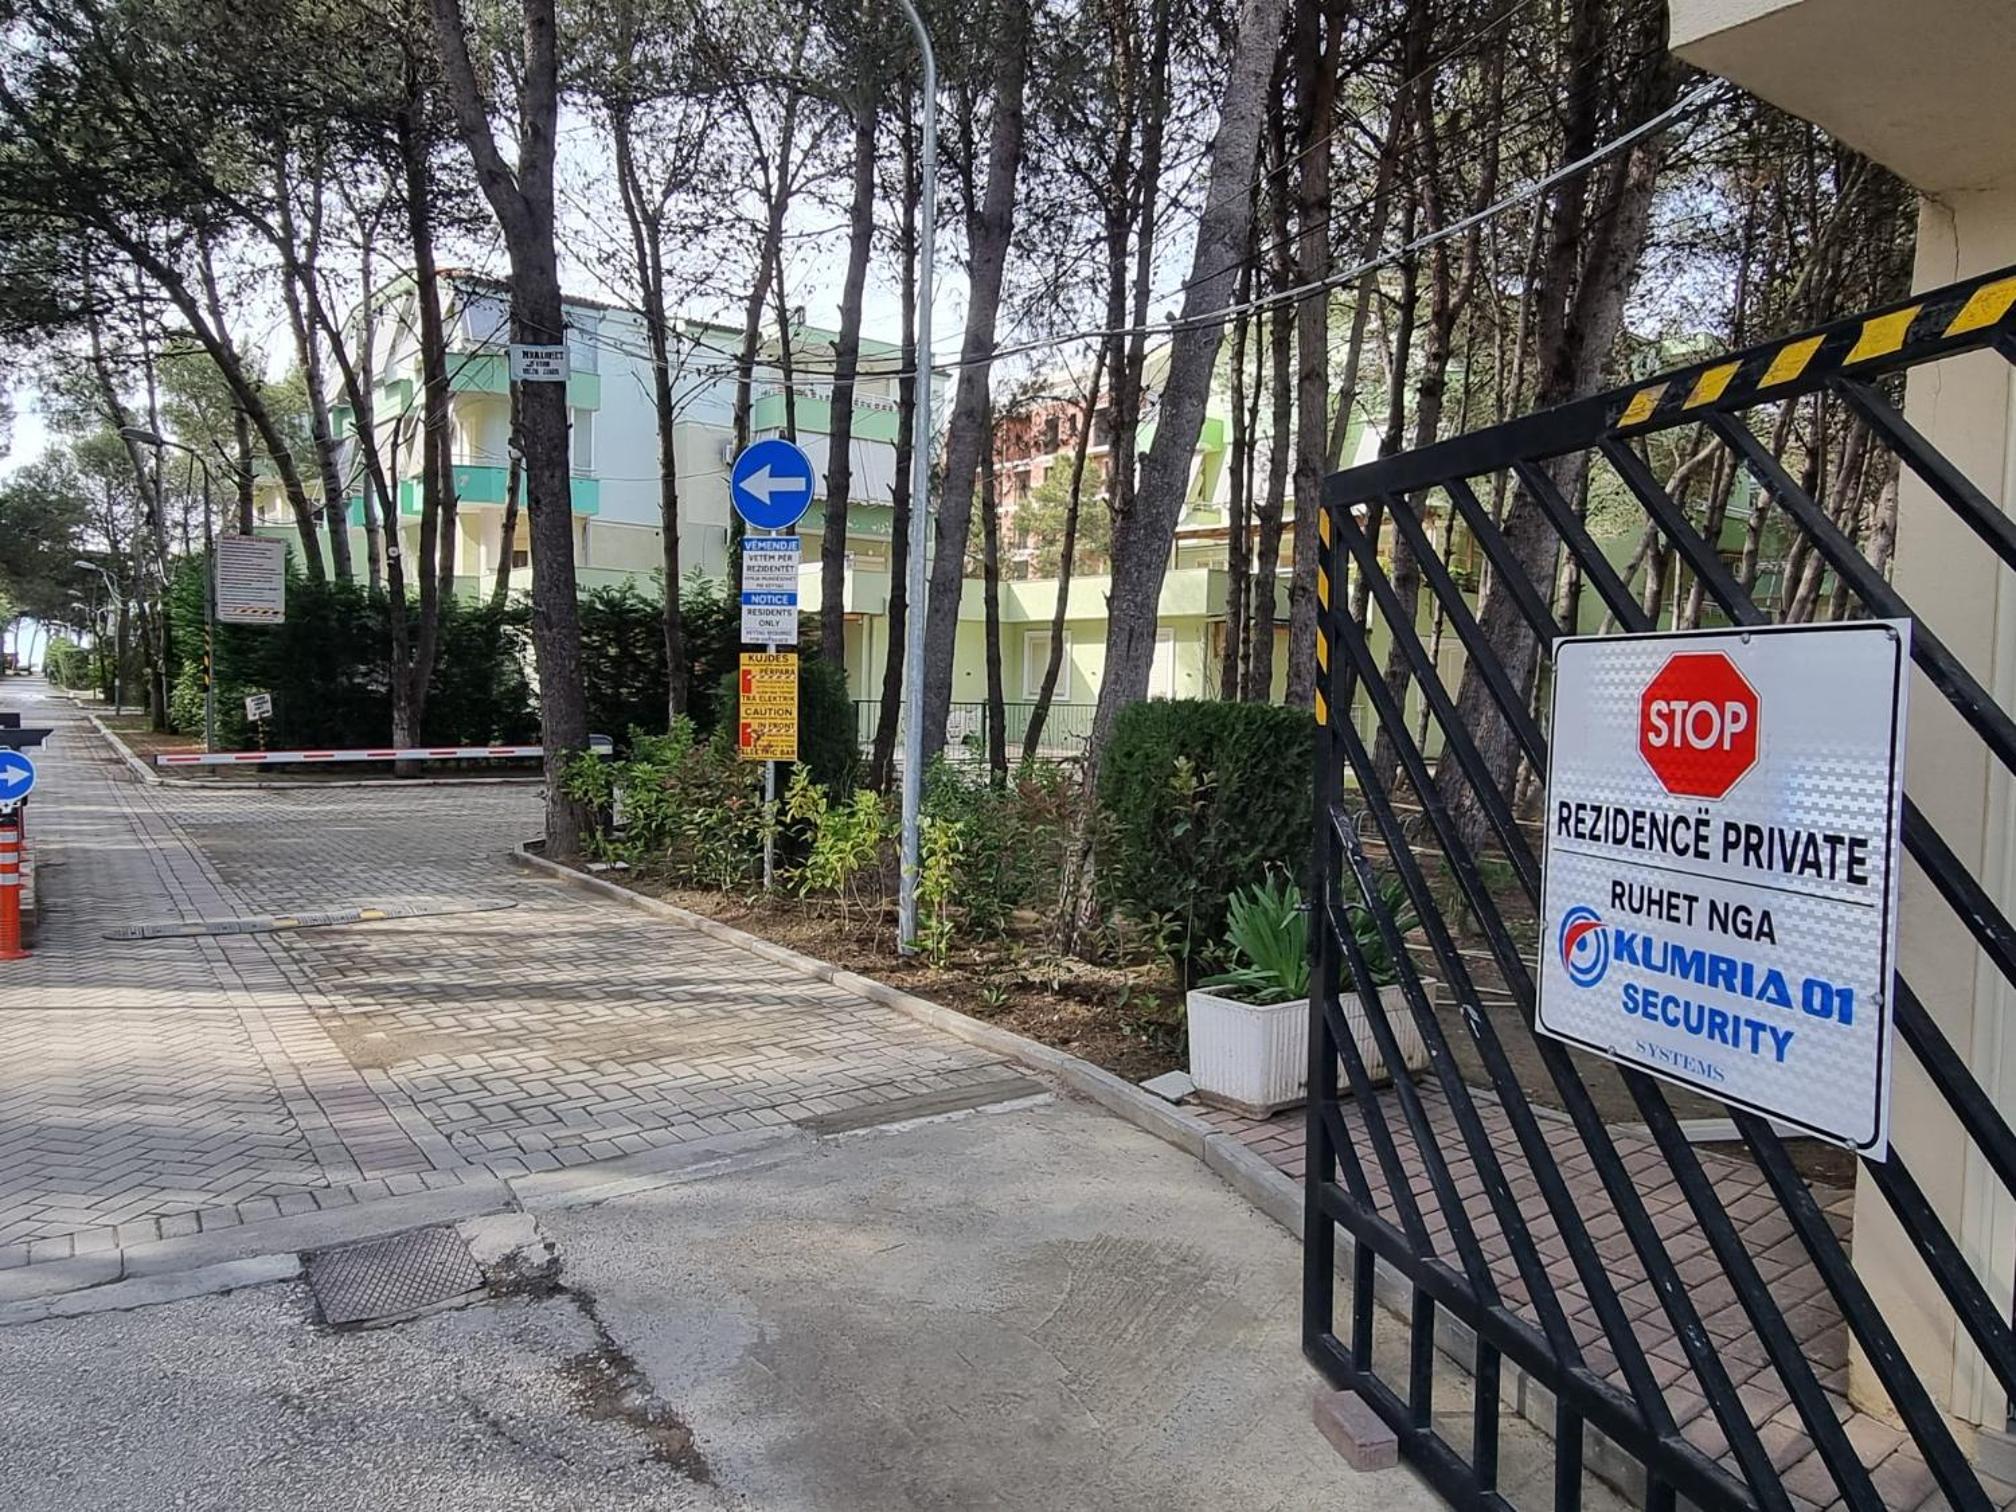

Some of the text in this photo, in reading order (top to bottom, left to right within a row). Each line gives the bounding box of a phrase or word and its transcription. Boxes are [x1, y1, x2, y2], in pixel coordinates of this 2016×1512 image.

[746, 608, 793, 616] RESIDENTS
[751, 594, 789, 604] NOTICE
[758, 619, 780, 627] ONLY
[748, 654, 790, 663] KUJDES
[744, 707, 793, 716] CAUTION
[1647, 699, 1748, 751] STOP
[779, 748, 797, 756] BAR
[1556, 800, 1869, 886] REZIDENCË PRIVATE
[1610, 880, 1777, 945] RUHET NGA
[1613, 929, 1855, 1026] KUMRIA 01
[1621, 983, 1795, 1064] SECURITY
[1634, 1038, 1727, 1084] SYSTEMS
